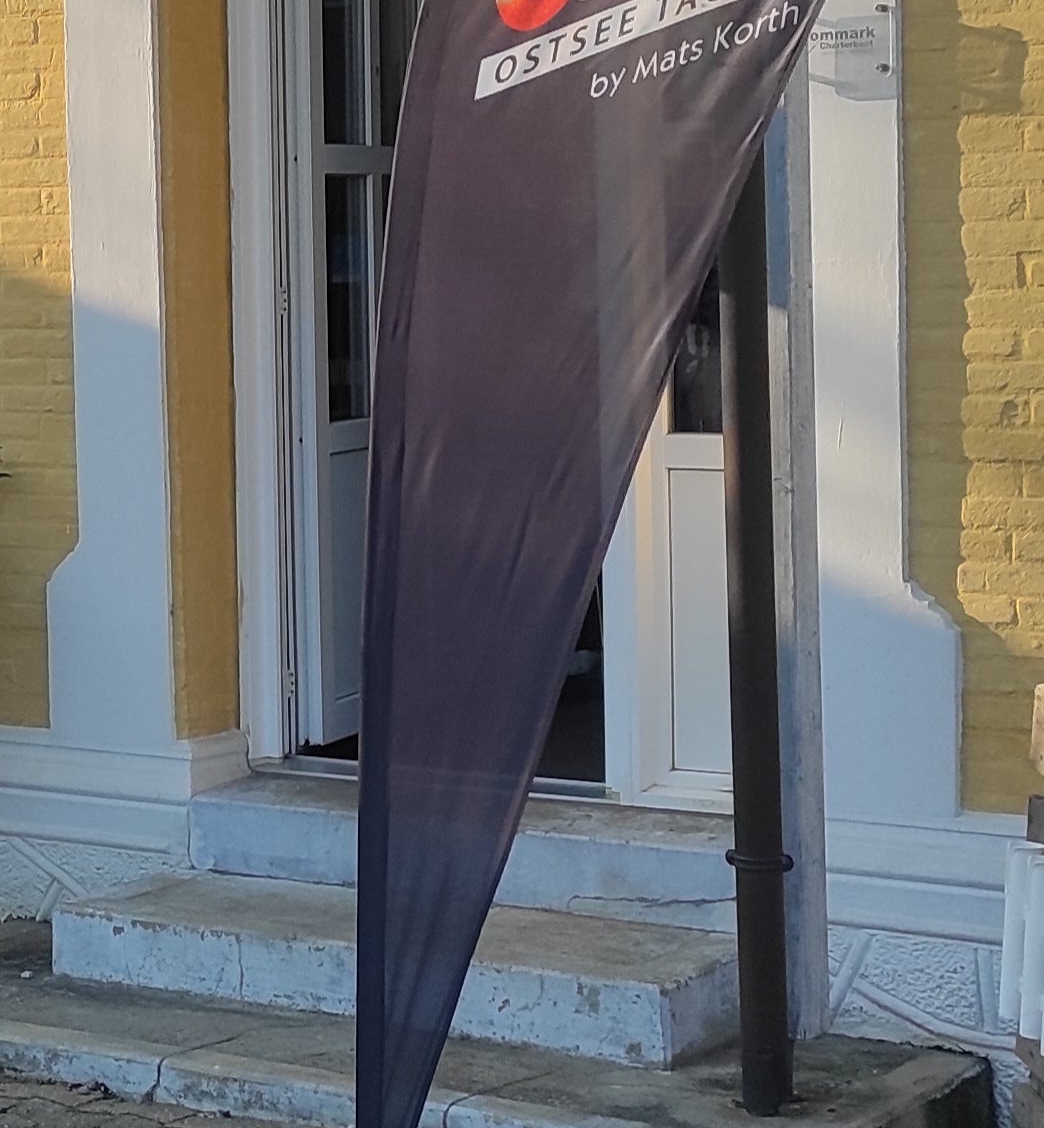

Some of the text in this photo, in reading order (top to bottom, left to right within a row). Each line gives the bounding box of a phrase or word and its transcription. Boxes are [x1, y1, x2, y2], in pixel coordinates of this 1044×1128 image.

[494, 6, 638, 85] OSTSEE
[590, 0, 800, 99] by Mats Korth
[810, 26, 876, 42] ommark
